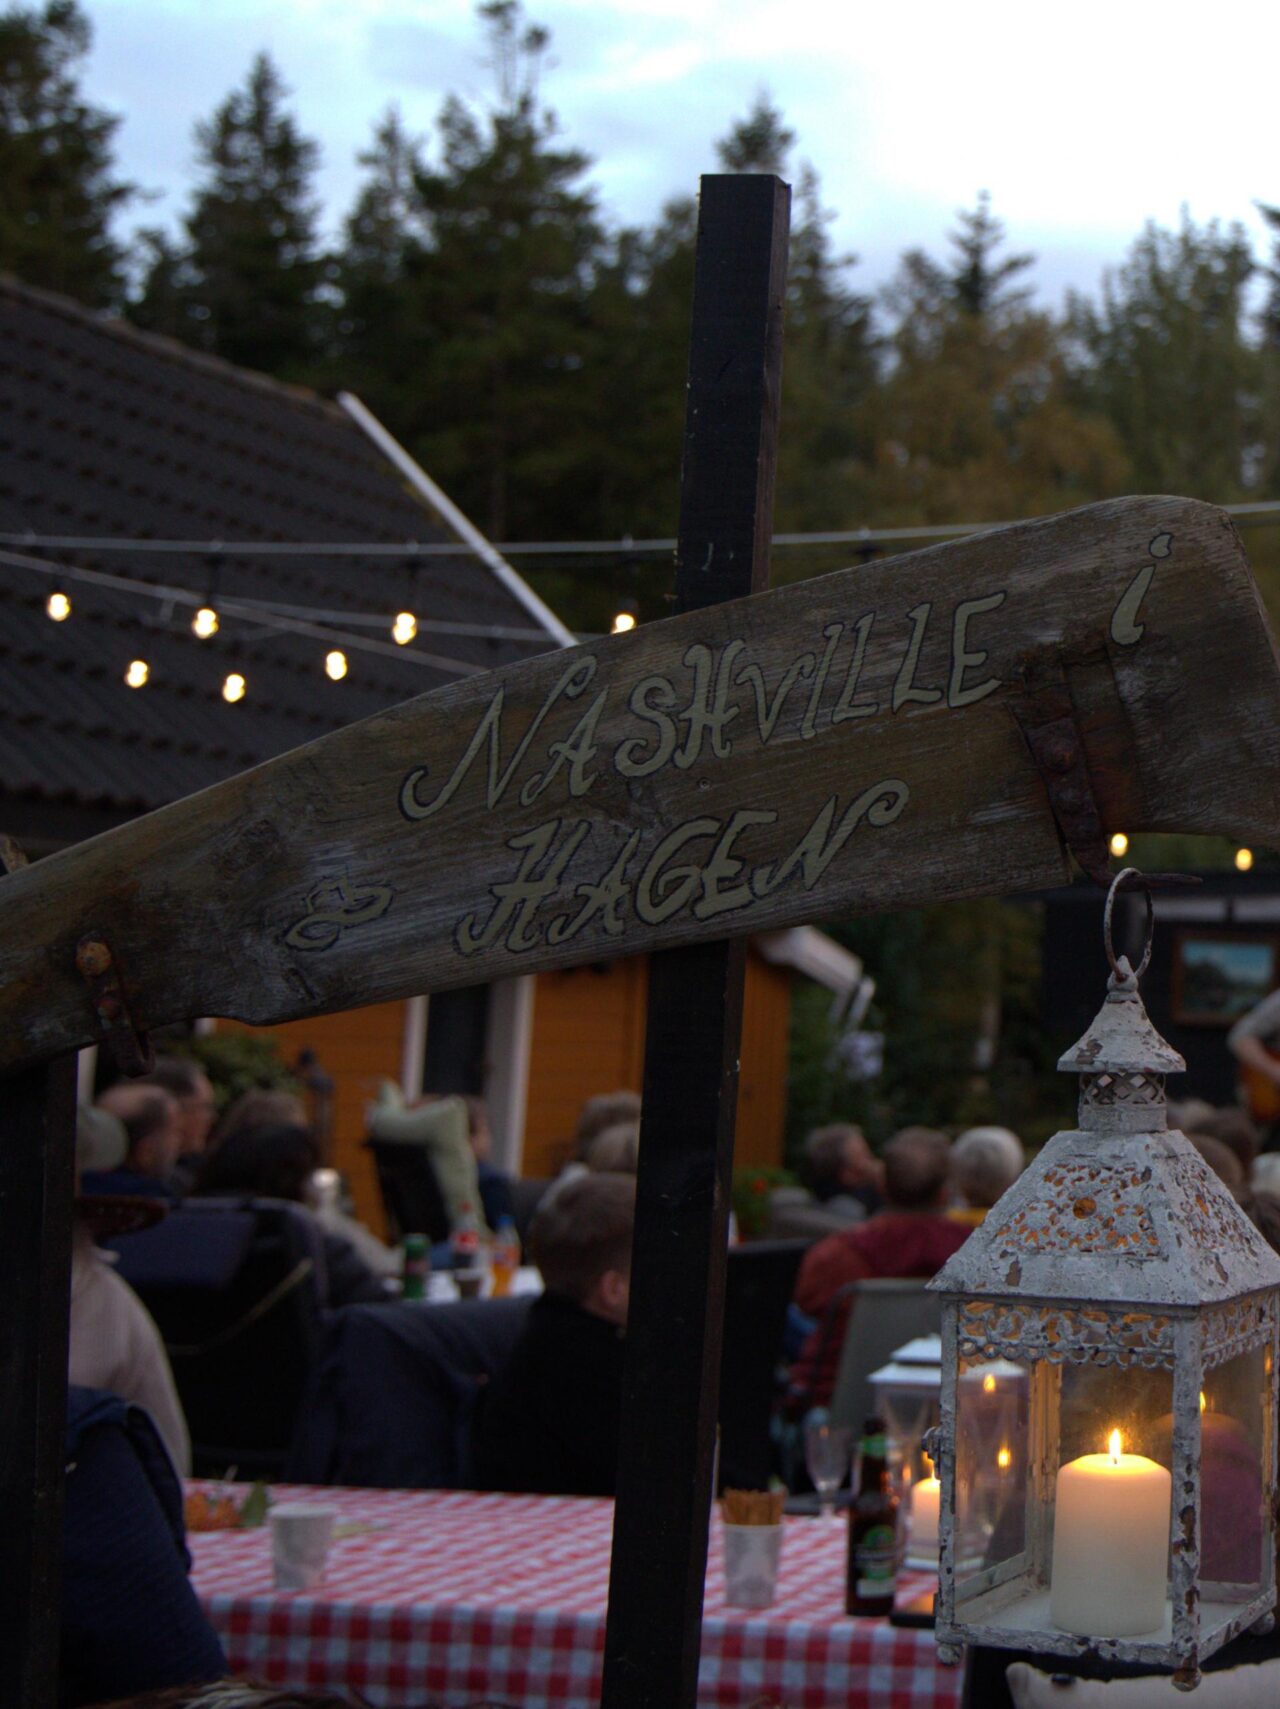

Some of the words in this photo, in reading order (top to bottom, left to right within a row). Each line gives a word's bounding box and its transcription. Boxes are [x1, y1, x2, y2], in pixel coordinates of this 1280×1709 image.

[399, 590, 1007, 822] NASHVILLE
[1110, 532, 1174, 647] i
[453, 779, 911, 956] HAGEN
